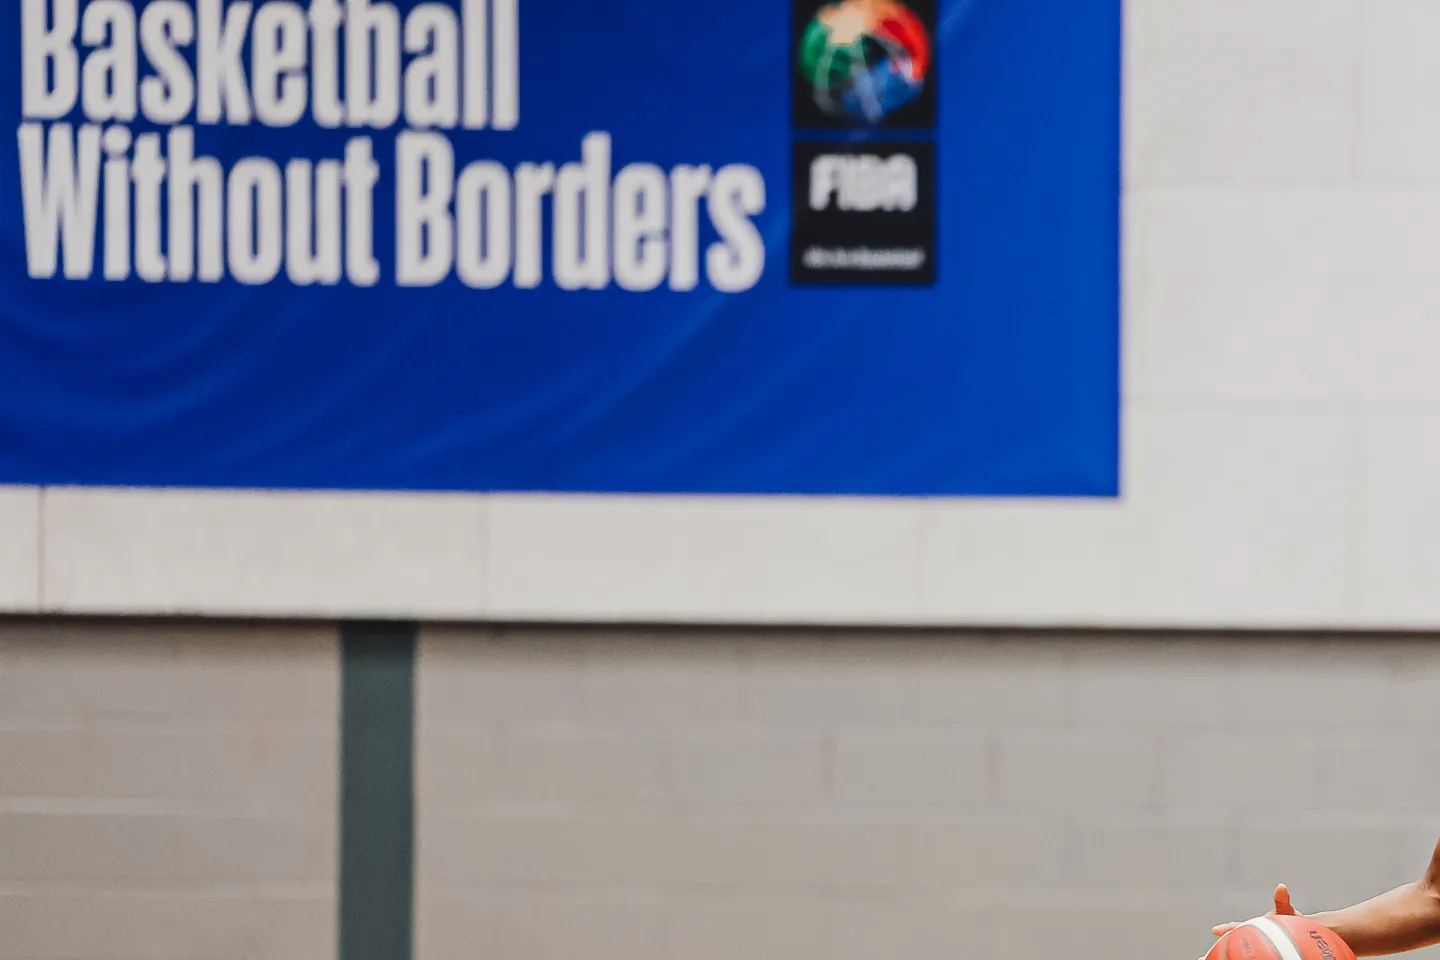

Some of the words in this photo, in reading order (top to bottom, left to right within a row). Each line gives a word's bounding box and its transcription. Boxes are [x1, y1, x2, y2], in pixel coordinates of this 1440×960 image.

[20, 0, 519, 130] Basketball
[17, 122, 379, 287] Without
[395, 130, 766, 293] Borders
